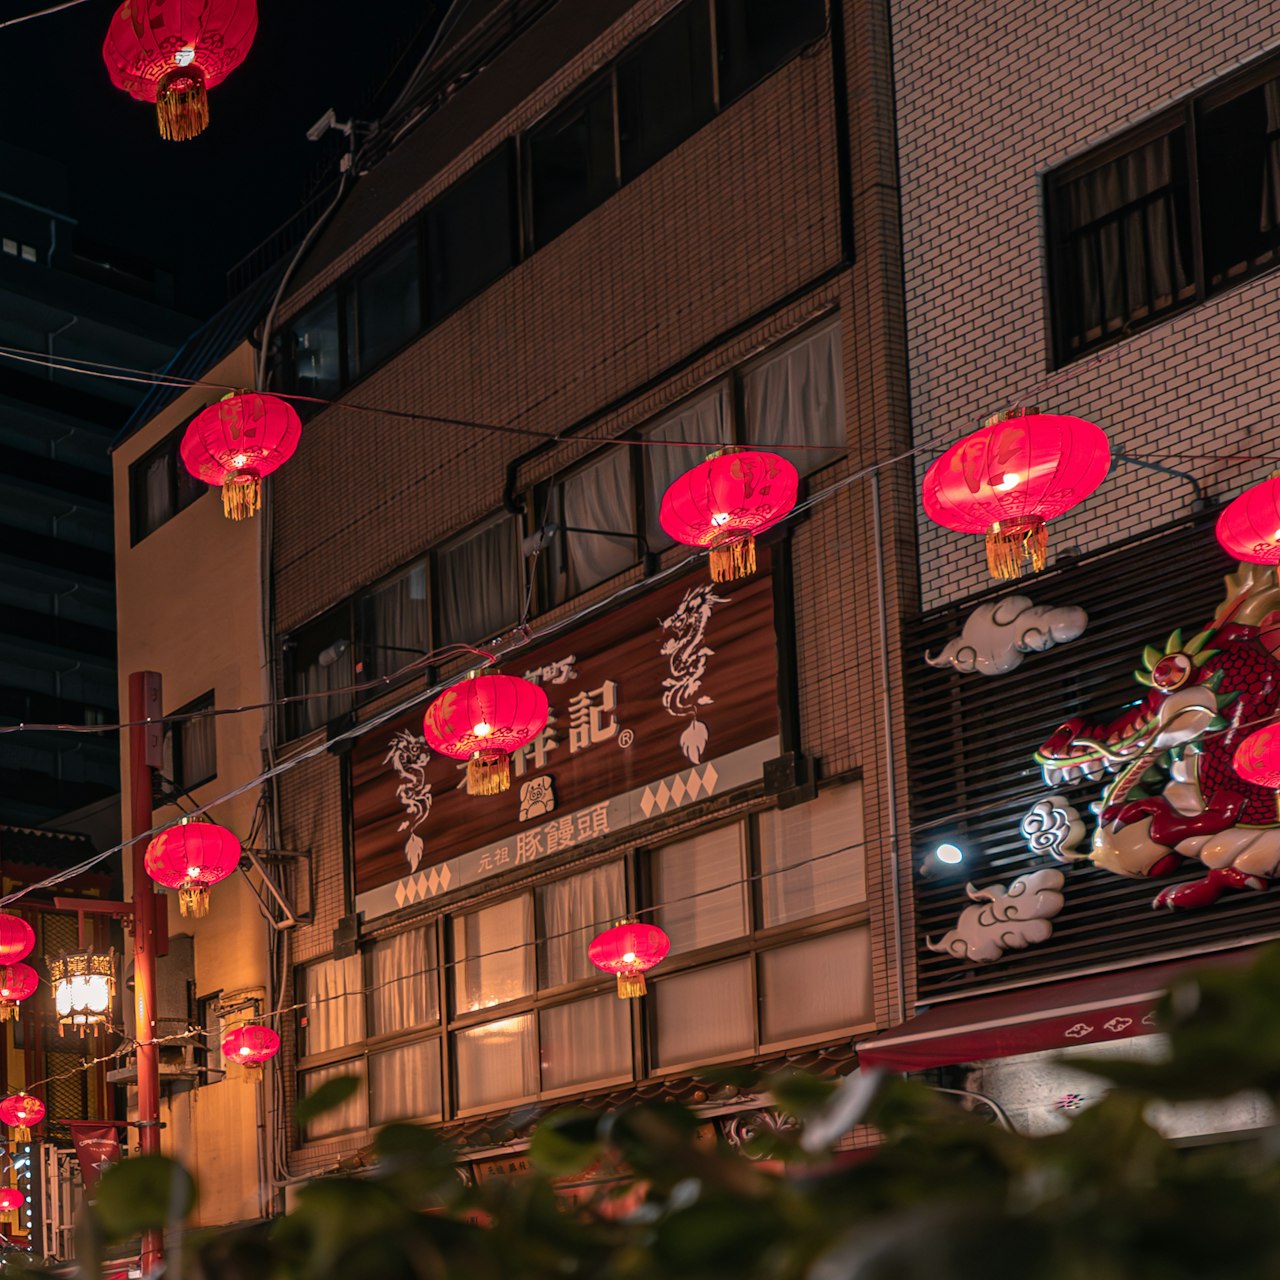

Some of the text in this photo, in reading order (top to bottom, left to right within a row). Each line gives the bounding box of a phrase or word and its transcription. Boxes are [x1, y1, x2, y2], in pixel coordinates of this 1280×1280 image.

[477, 800, 611, 873] 元祖 豚饅頭
